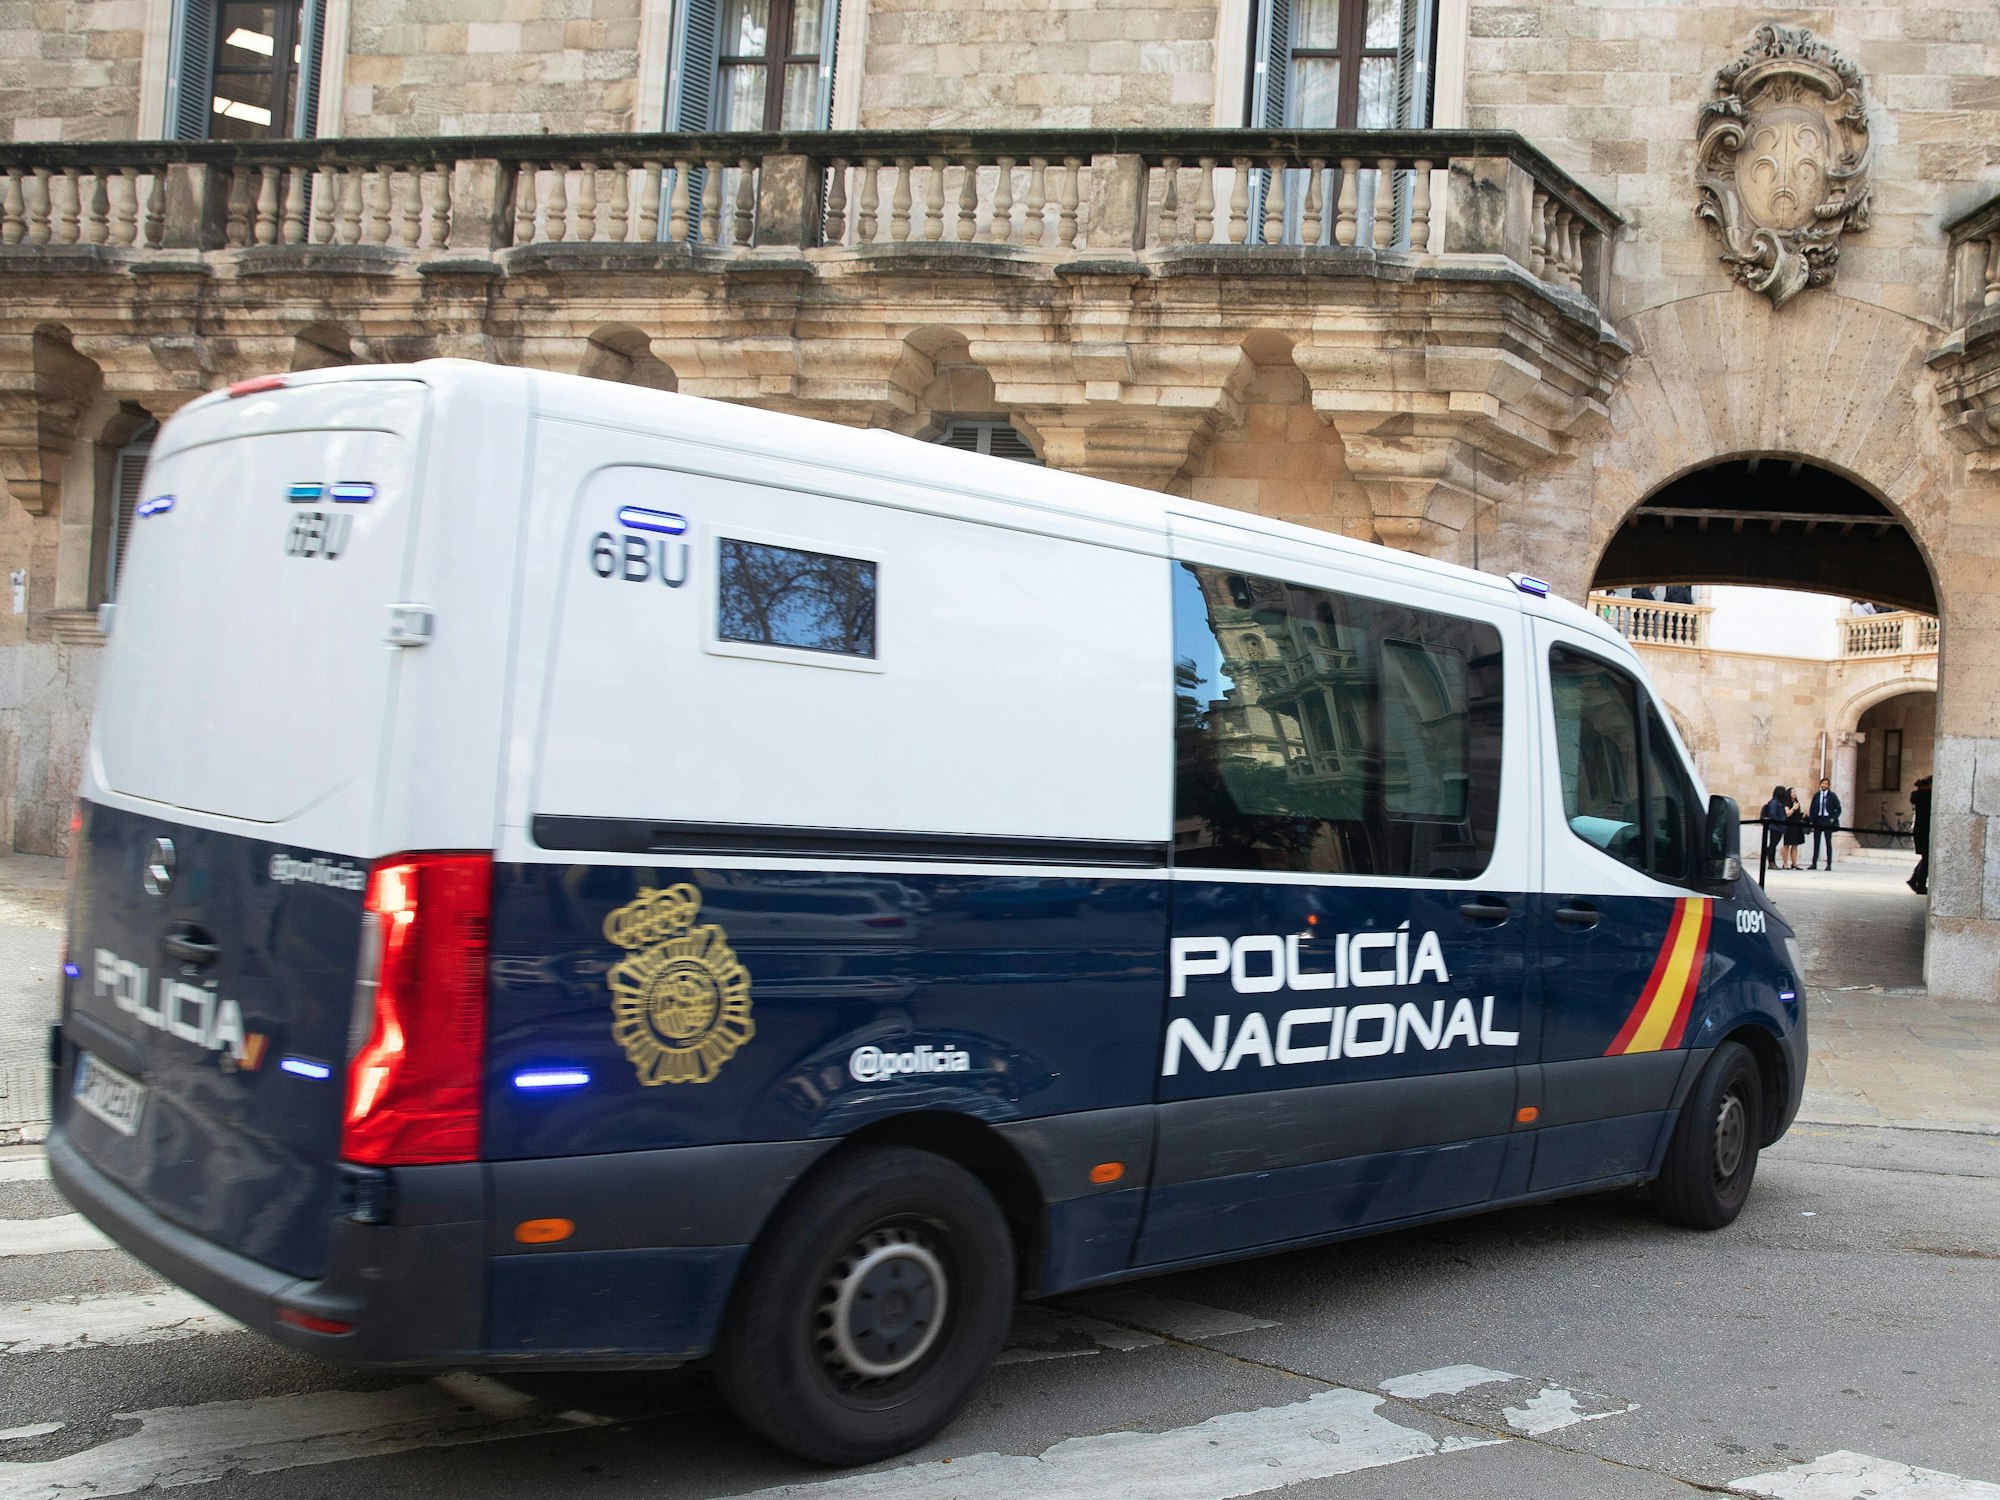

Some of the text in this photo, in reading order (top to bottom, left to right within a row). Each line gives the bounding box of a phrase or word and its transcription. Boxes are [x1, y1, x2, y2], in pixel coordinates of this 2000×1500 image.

[286, 511, 352, 560] 6BU
[590, 531, 690, 588] 6BU
[269, 854, 366, 891] @policia
[1169, 919, 1450, 998] POLICÍA
[93, 947, 246, 1060] POLICÍA
[848, 1044, 970, 1083] @policia
[1161, 995, 1520, 1076] NACIONAL
